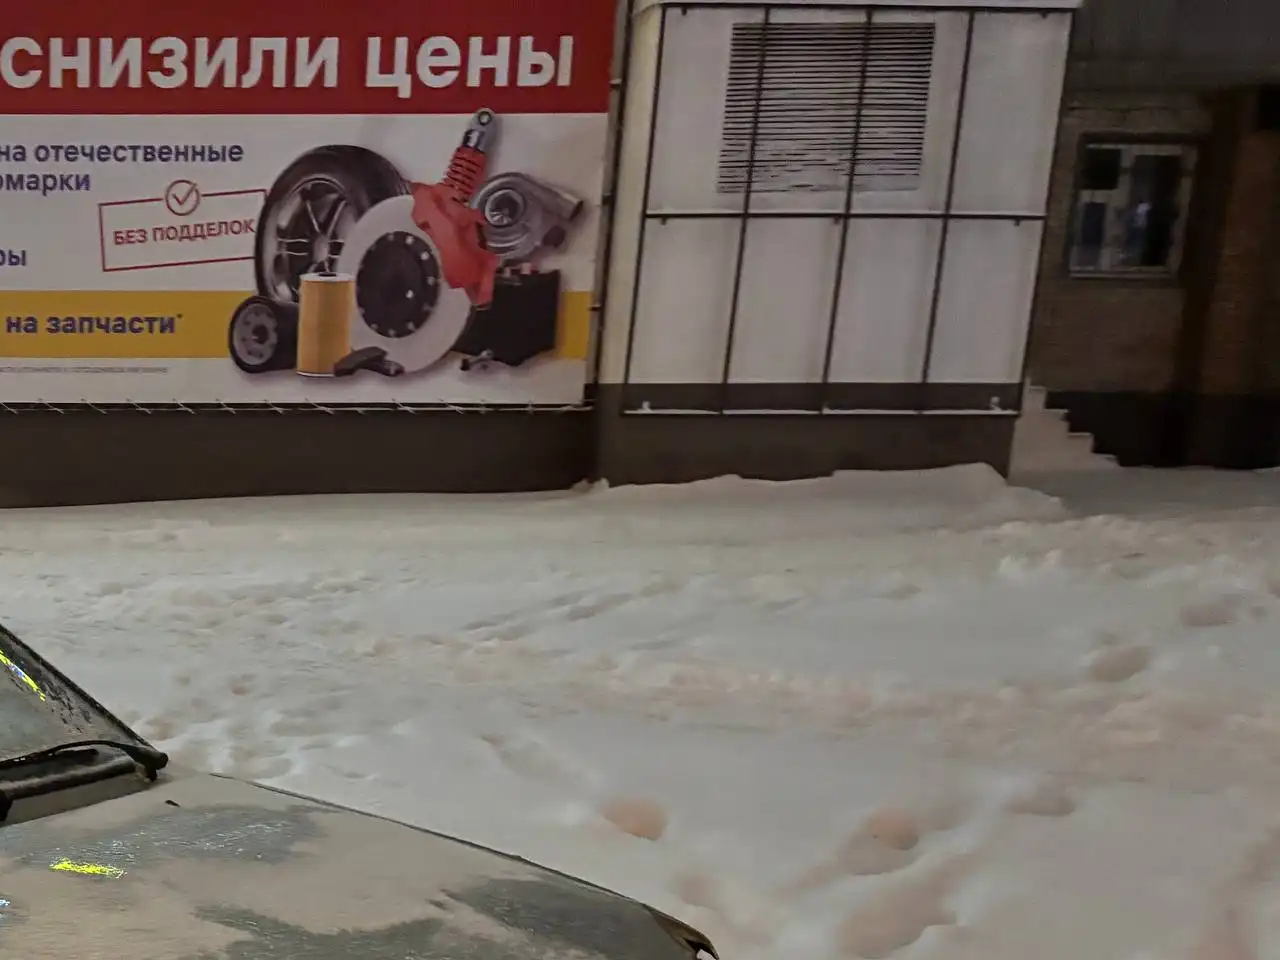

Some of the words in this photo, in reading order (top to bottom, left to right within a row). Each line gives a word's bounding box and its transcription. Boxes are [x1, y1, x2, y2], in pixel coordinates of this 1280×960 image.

[366, 35, 573, 98] цены
[34, 143, 244, 163] отечественные
[113, 228, 148, 246] БЕЗ
[152, 218, 256, 242] ПОДДЕЛОК
[6, 312, 38, 334] на
